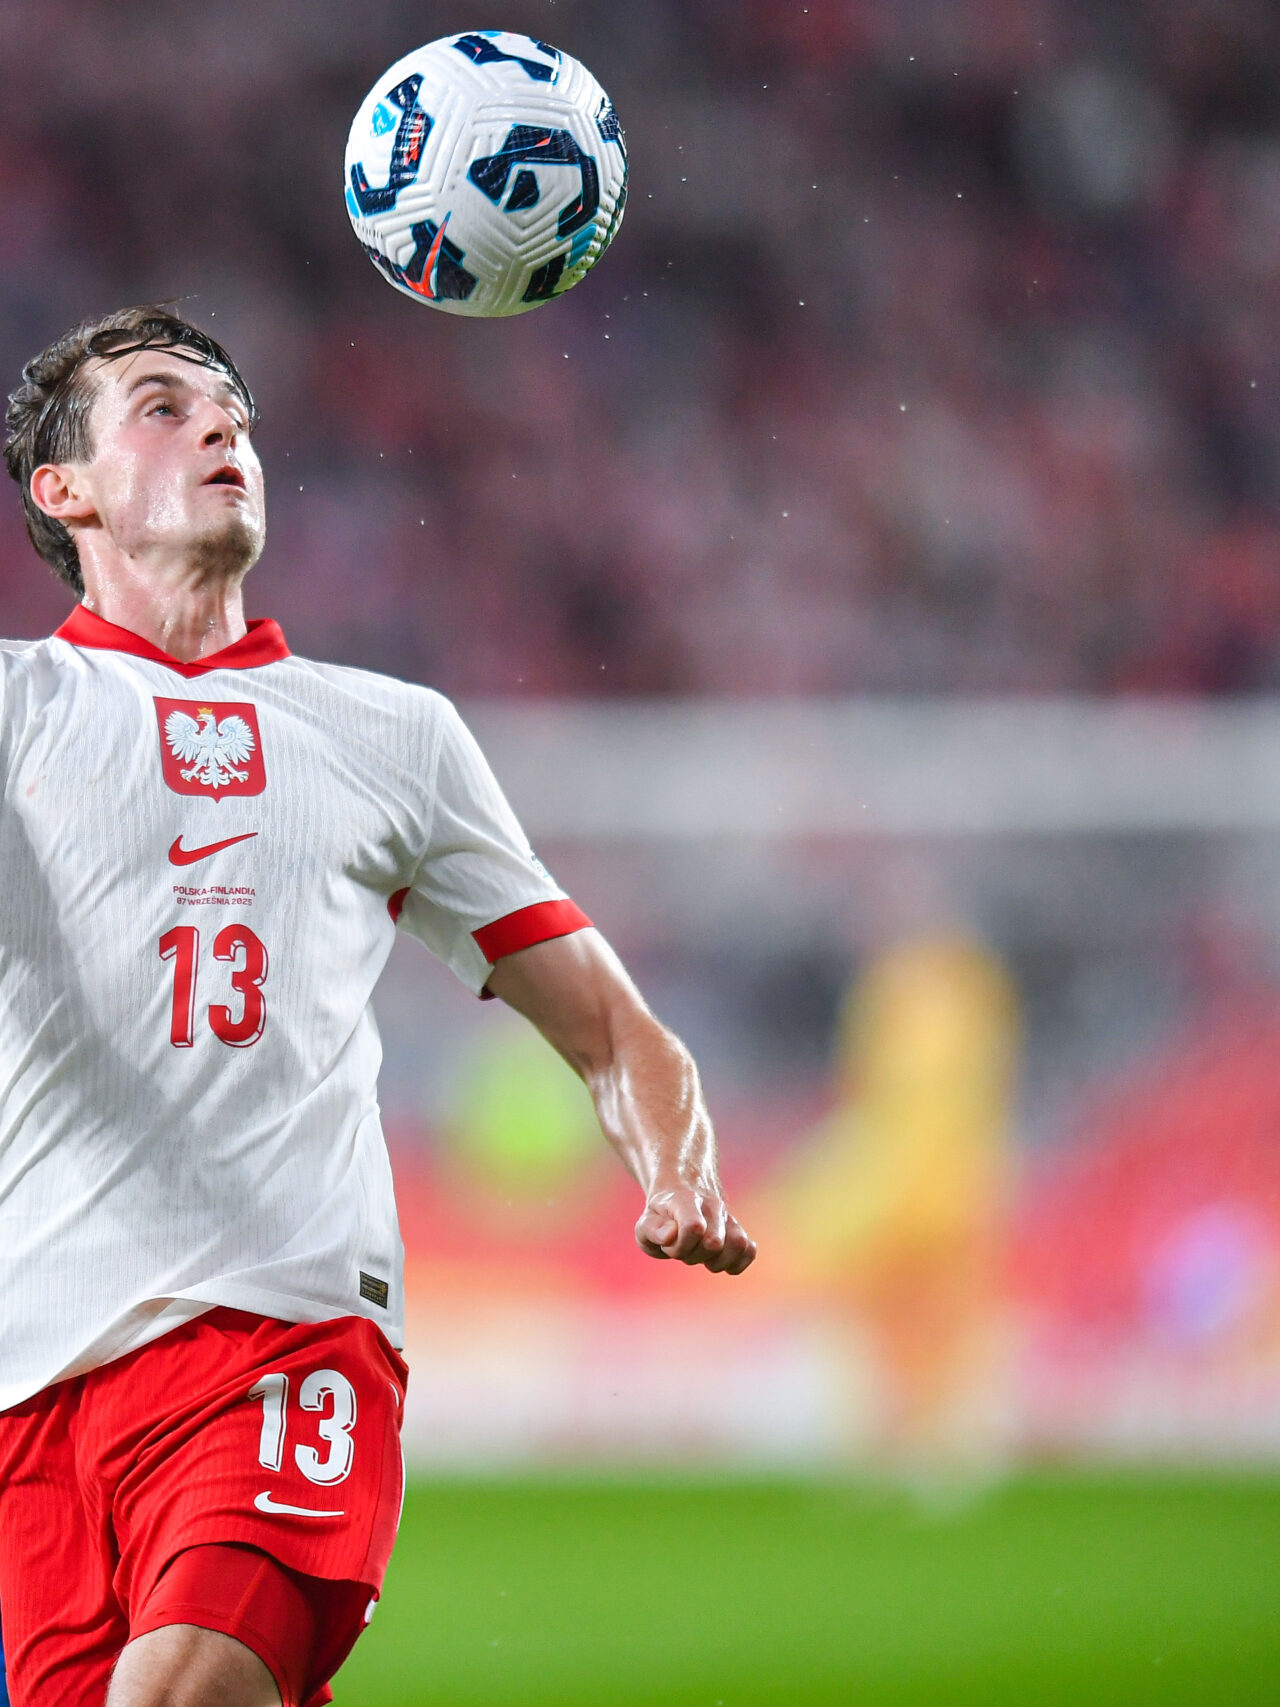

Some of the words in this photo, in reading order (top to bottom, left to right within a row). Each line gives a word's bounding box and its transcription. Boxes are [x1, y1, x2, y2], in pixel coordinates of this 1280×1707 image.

[173, 886, 256, 896] POLSKA-FINLANDIA
[187, 896, 230, 906] WRZEŚNIA
[231, 897, 253, 906] 2025
[159, 923, 269, 1048] 13
[247, 1368, 357, 1487] 13
